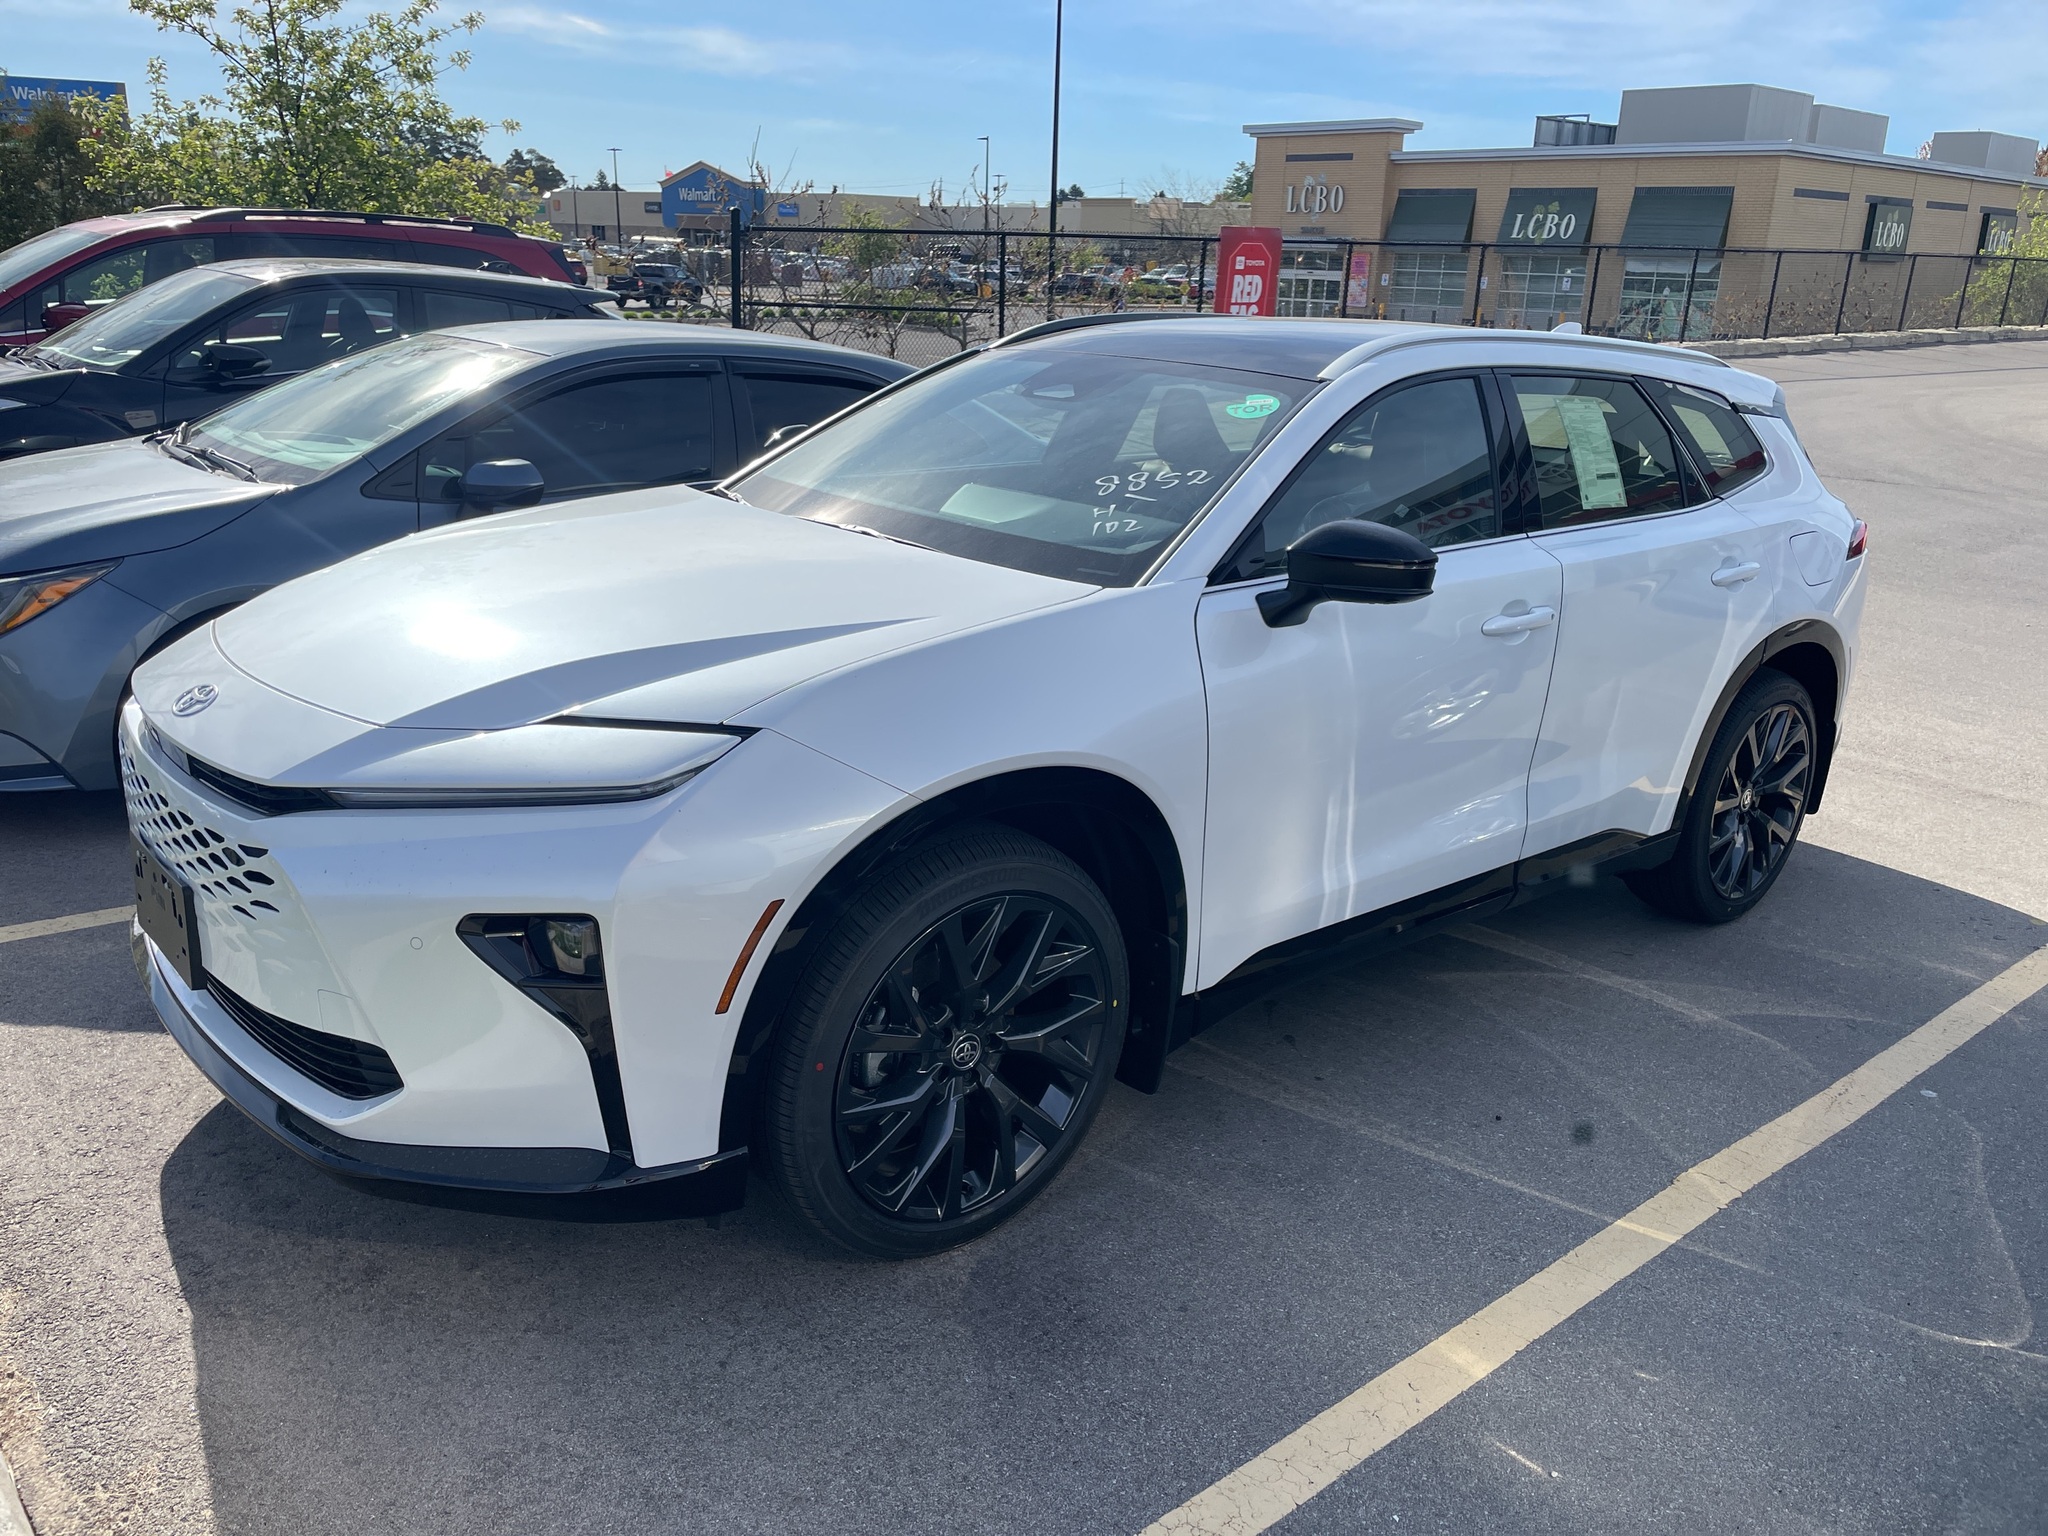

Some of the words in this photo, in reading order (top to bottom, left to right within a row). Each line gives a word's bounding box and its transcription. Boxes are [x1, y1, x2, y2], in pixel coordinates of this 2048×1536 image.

[678, 187, 716, 201] Walmart
[1286, 185, 1344, 213] LCBO
[1510, 213, 1576, 239] LCBO
[1875, 221, 1904, 247] LCBO
[1231, 274, 1263, 303] RED
[1230, 404, 1273, 415] TOR
[1095, 469, 1215, 496] 8852
[1092, 519, 1143, 536] 102
